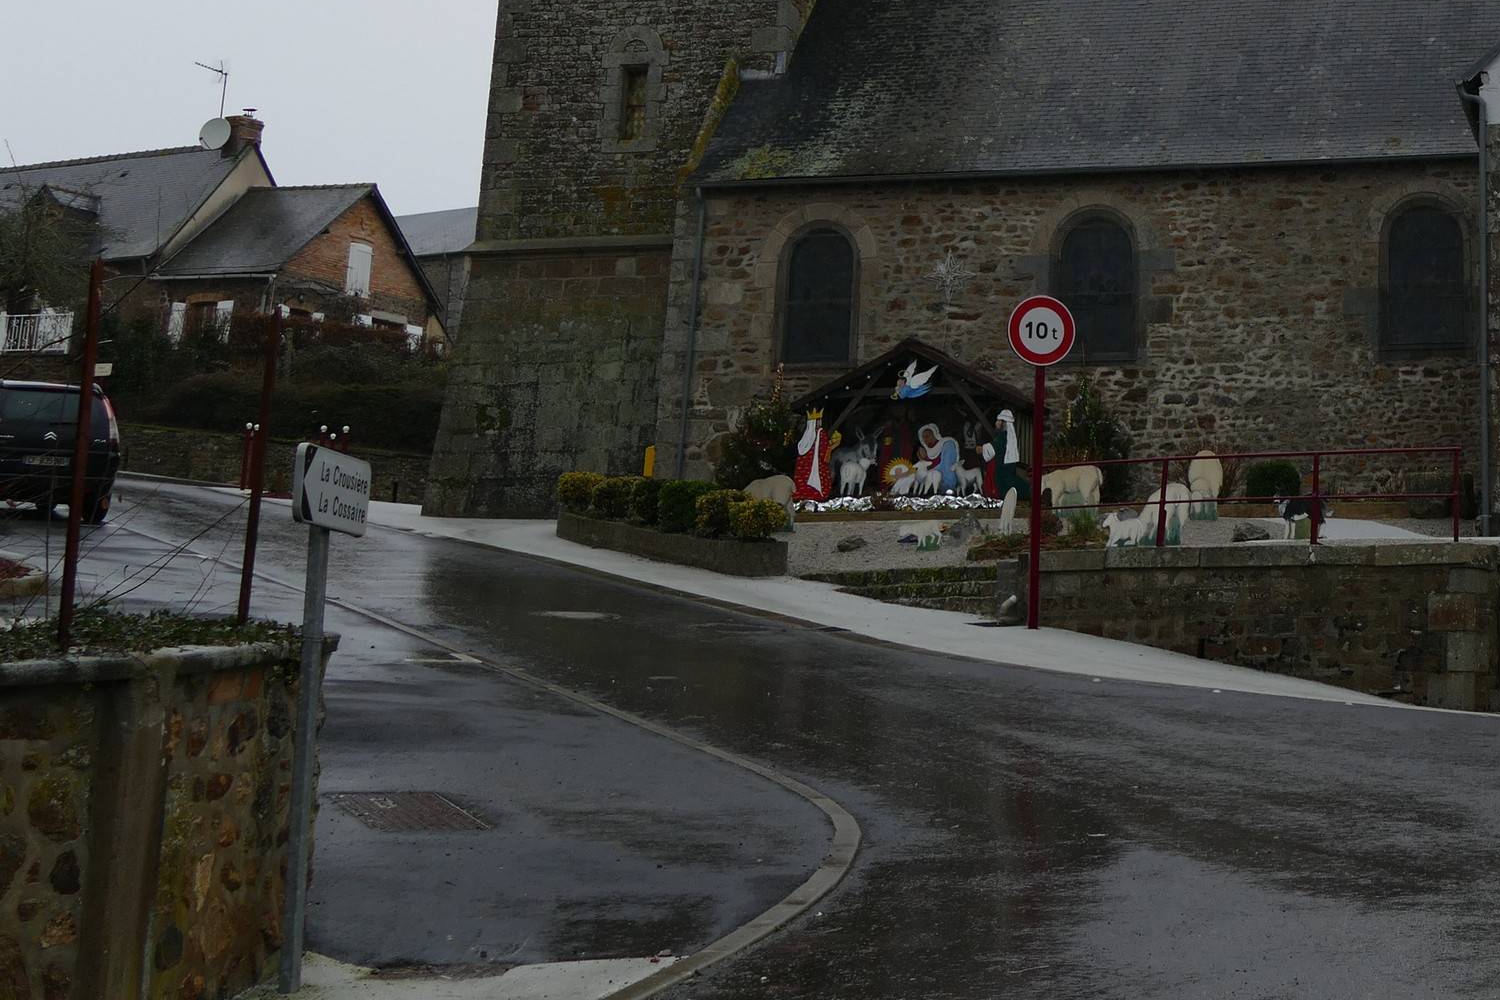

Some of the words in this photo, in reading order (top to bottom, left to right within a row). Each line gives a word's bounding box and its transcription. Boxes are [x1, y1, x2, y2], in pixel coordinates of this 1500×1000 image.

[1026, 321, 1048, 339] 10
[1051, 327, 1058, 340] t
[320, 461, 330, 482] La
[333, 465, 368, 494] Crousière
[318, 491, 329, 513] La
[333, 496, 366, 523] Cossaire
